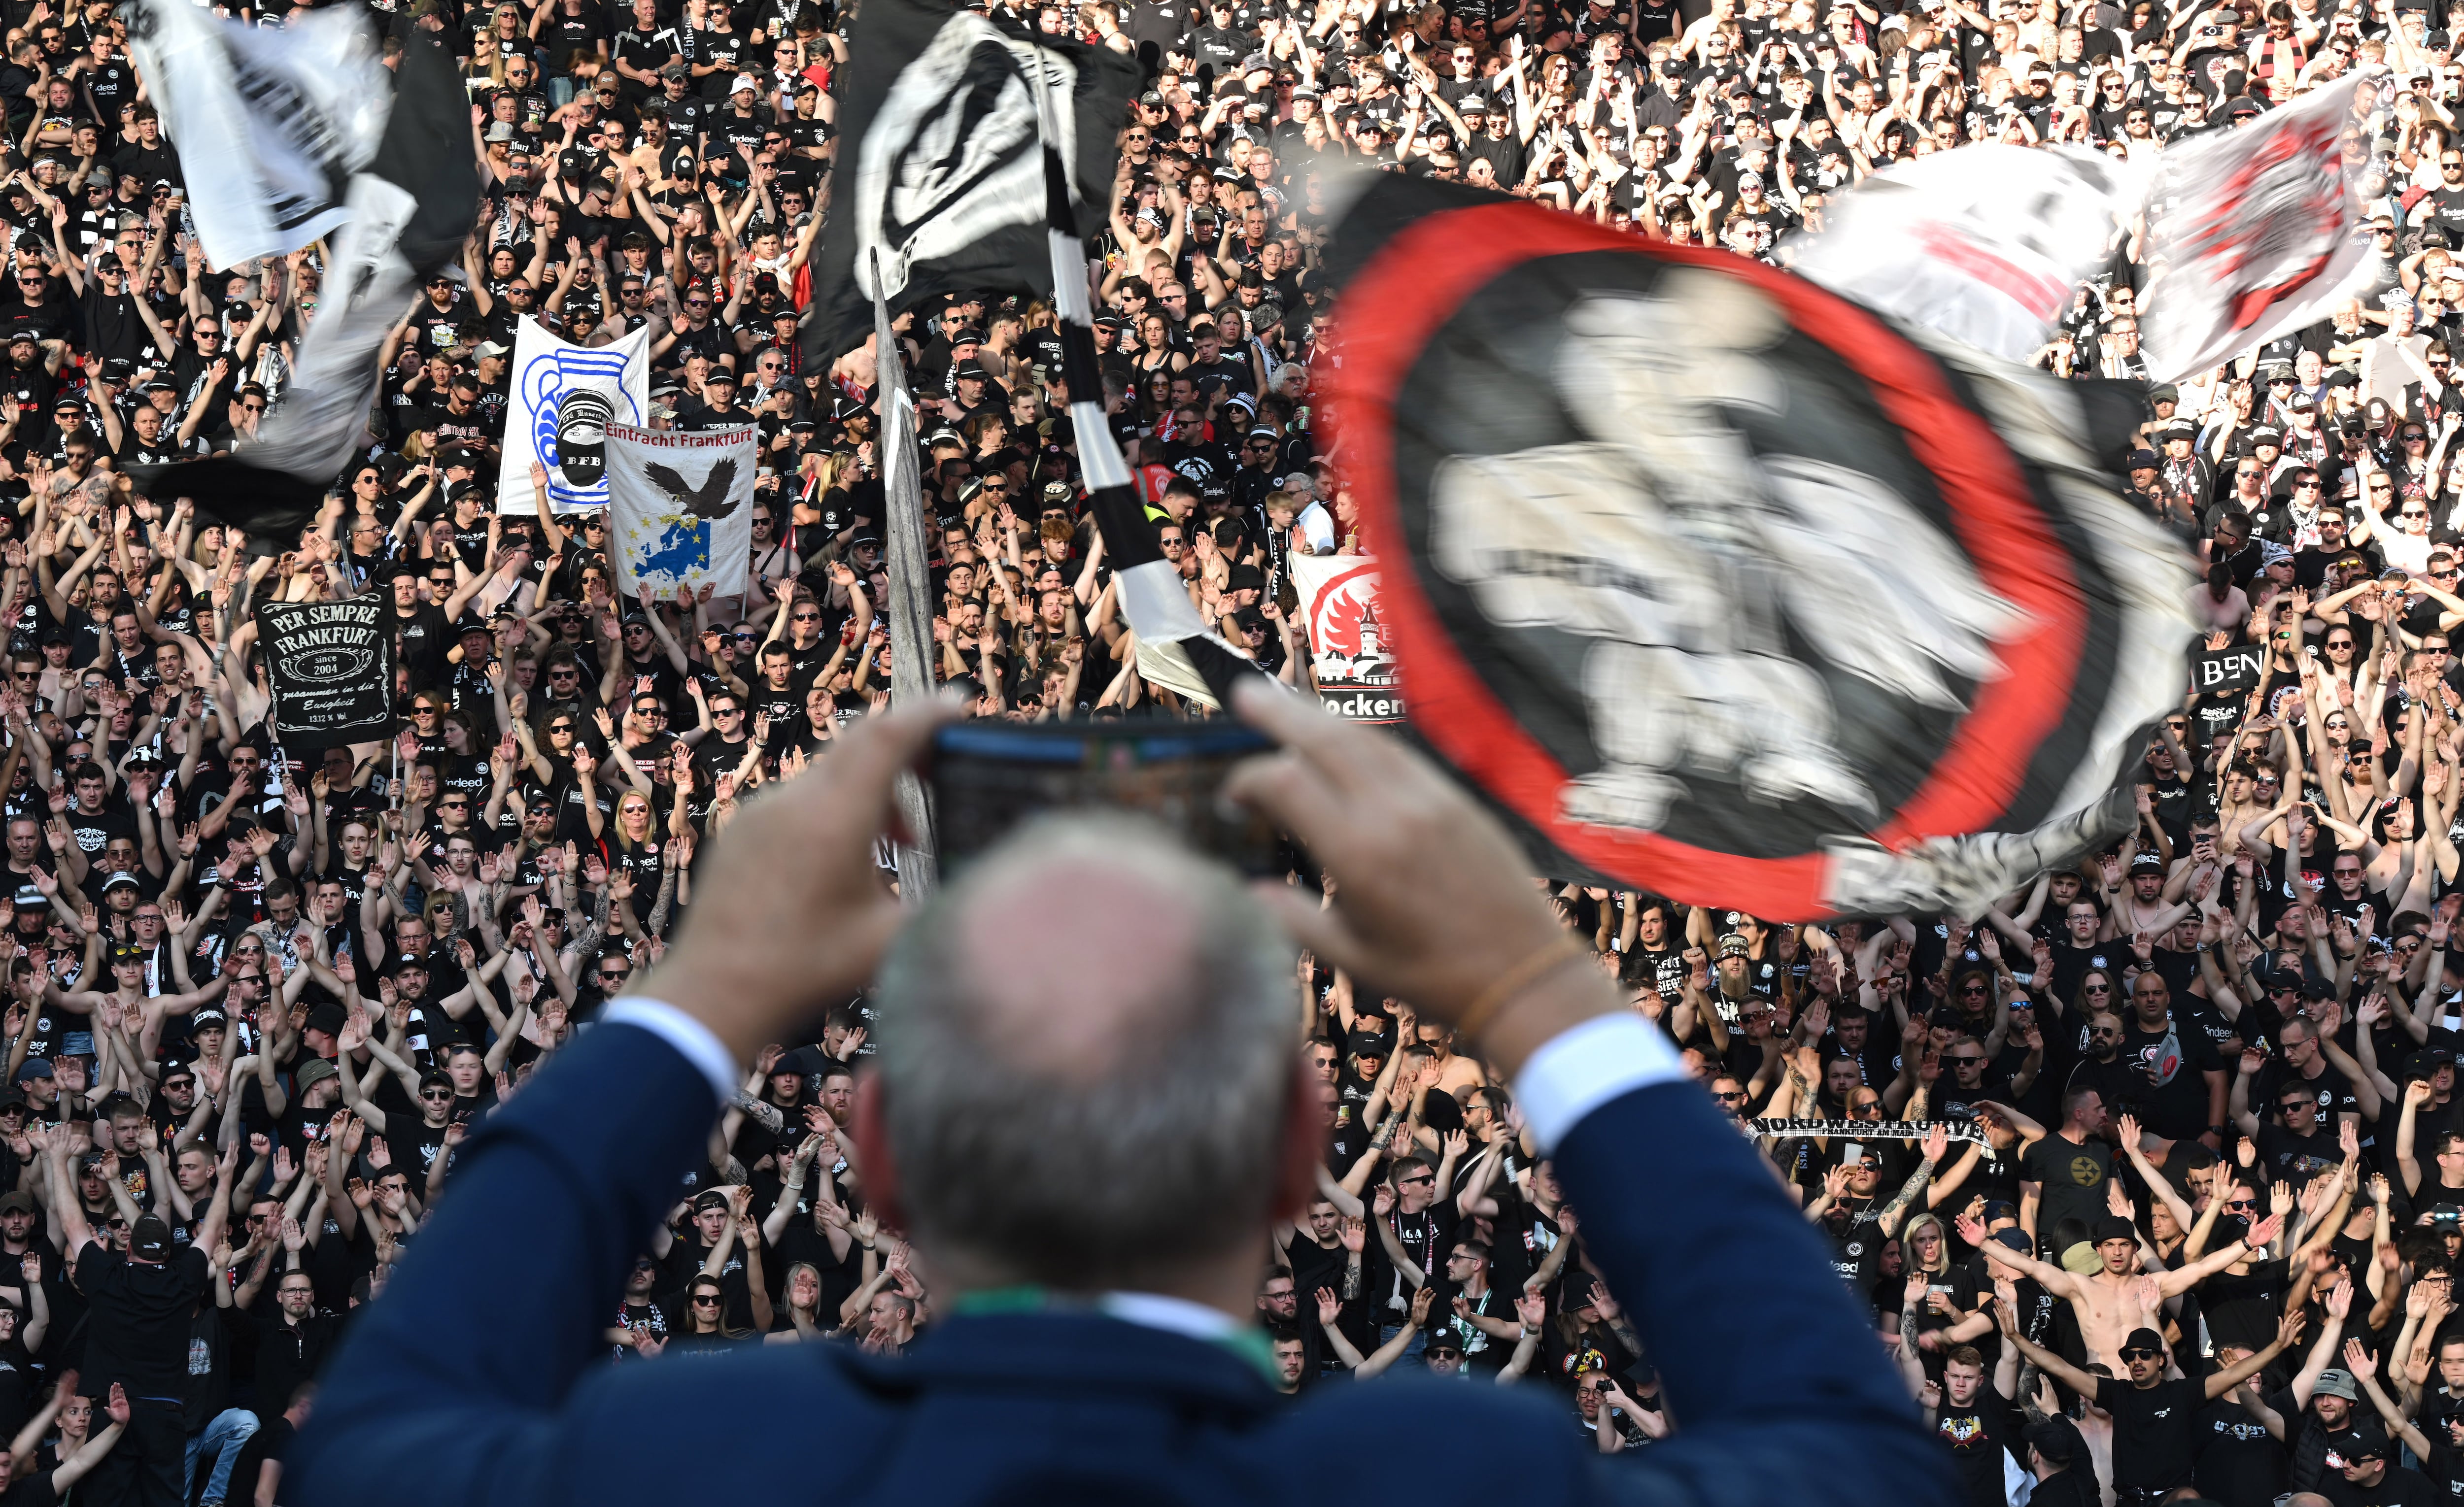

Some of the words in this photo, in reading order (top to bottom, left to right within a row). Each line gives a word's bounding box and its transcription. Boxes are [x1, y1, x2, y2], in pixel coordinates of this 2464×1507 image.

[709, 51, 736, 60] indeed
[727, 134, 761, 144] indeed
[606, 422, 676, 446] Eintracht
[680, 428, 753, 447] Frankfurt
[1122, 425, 1136, 434] JOKA
[1203, 487, 1225, 497] Frankfurt
[271, 611, 308, 634] PER
[308, 605, 381, 625] SEMPRE
[274, 627, 378, 656] FRANKFURT
[315, 655, 338, 664] since
[314, 664, 338, 675] 2004
[282, 688, 339, 701] zusammen
[357, 682, 375, 691] die
[303, 698, 356, 711] Ewigkeit
[1321, 694, 1407, 716] ocken
[2200, 706, 2237, 718] BERLIN
